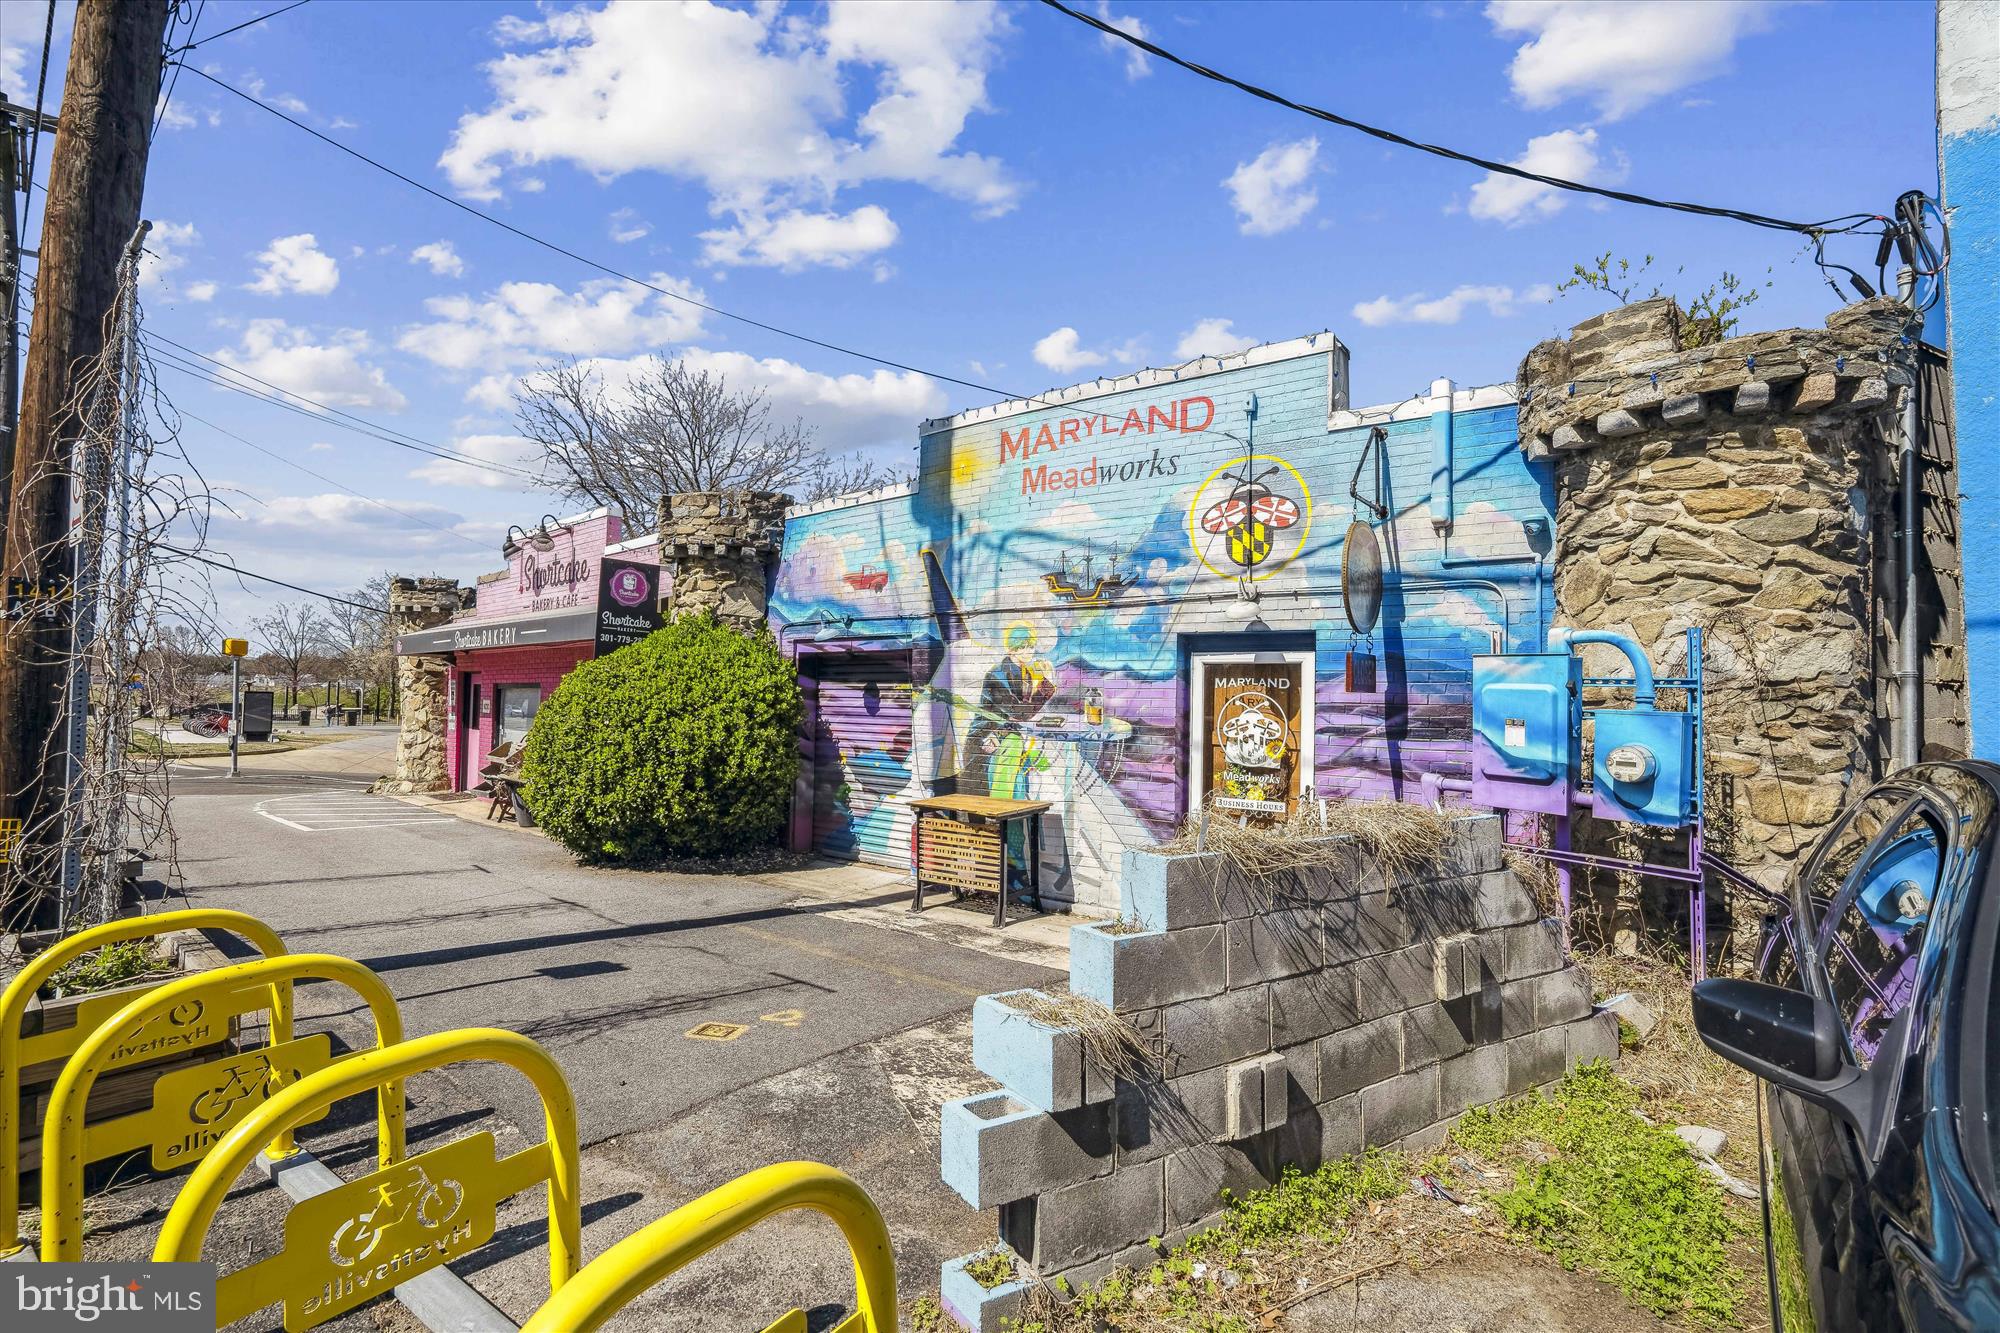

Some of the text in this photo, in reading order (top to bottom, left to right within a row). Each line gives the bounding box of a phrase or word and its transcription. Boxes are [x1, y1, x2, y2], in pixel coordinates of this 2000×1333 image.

[999, 395, 1215, 465] MARYLAND
[1021, 448, 1182, 496] Meadworks
[524, 549, 591, 592] Shortcake
[15, 583, 73, 602] 1412
[531, 597, 554, 613] BAKERY
[556, 597, 561, 608] &
[601, 610, 652, 629] Shortcake
[454, 627, 517, 649] Shortcake BAKERY
[600, 633, 646, 645] 301-779-28
[1214, 677, 1291, 690] MARYLAND
[1223, 771, 1281, 784] Meadworks
[1216, 798, 1284, 811] BUSINESS HOURS
